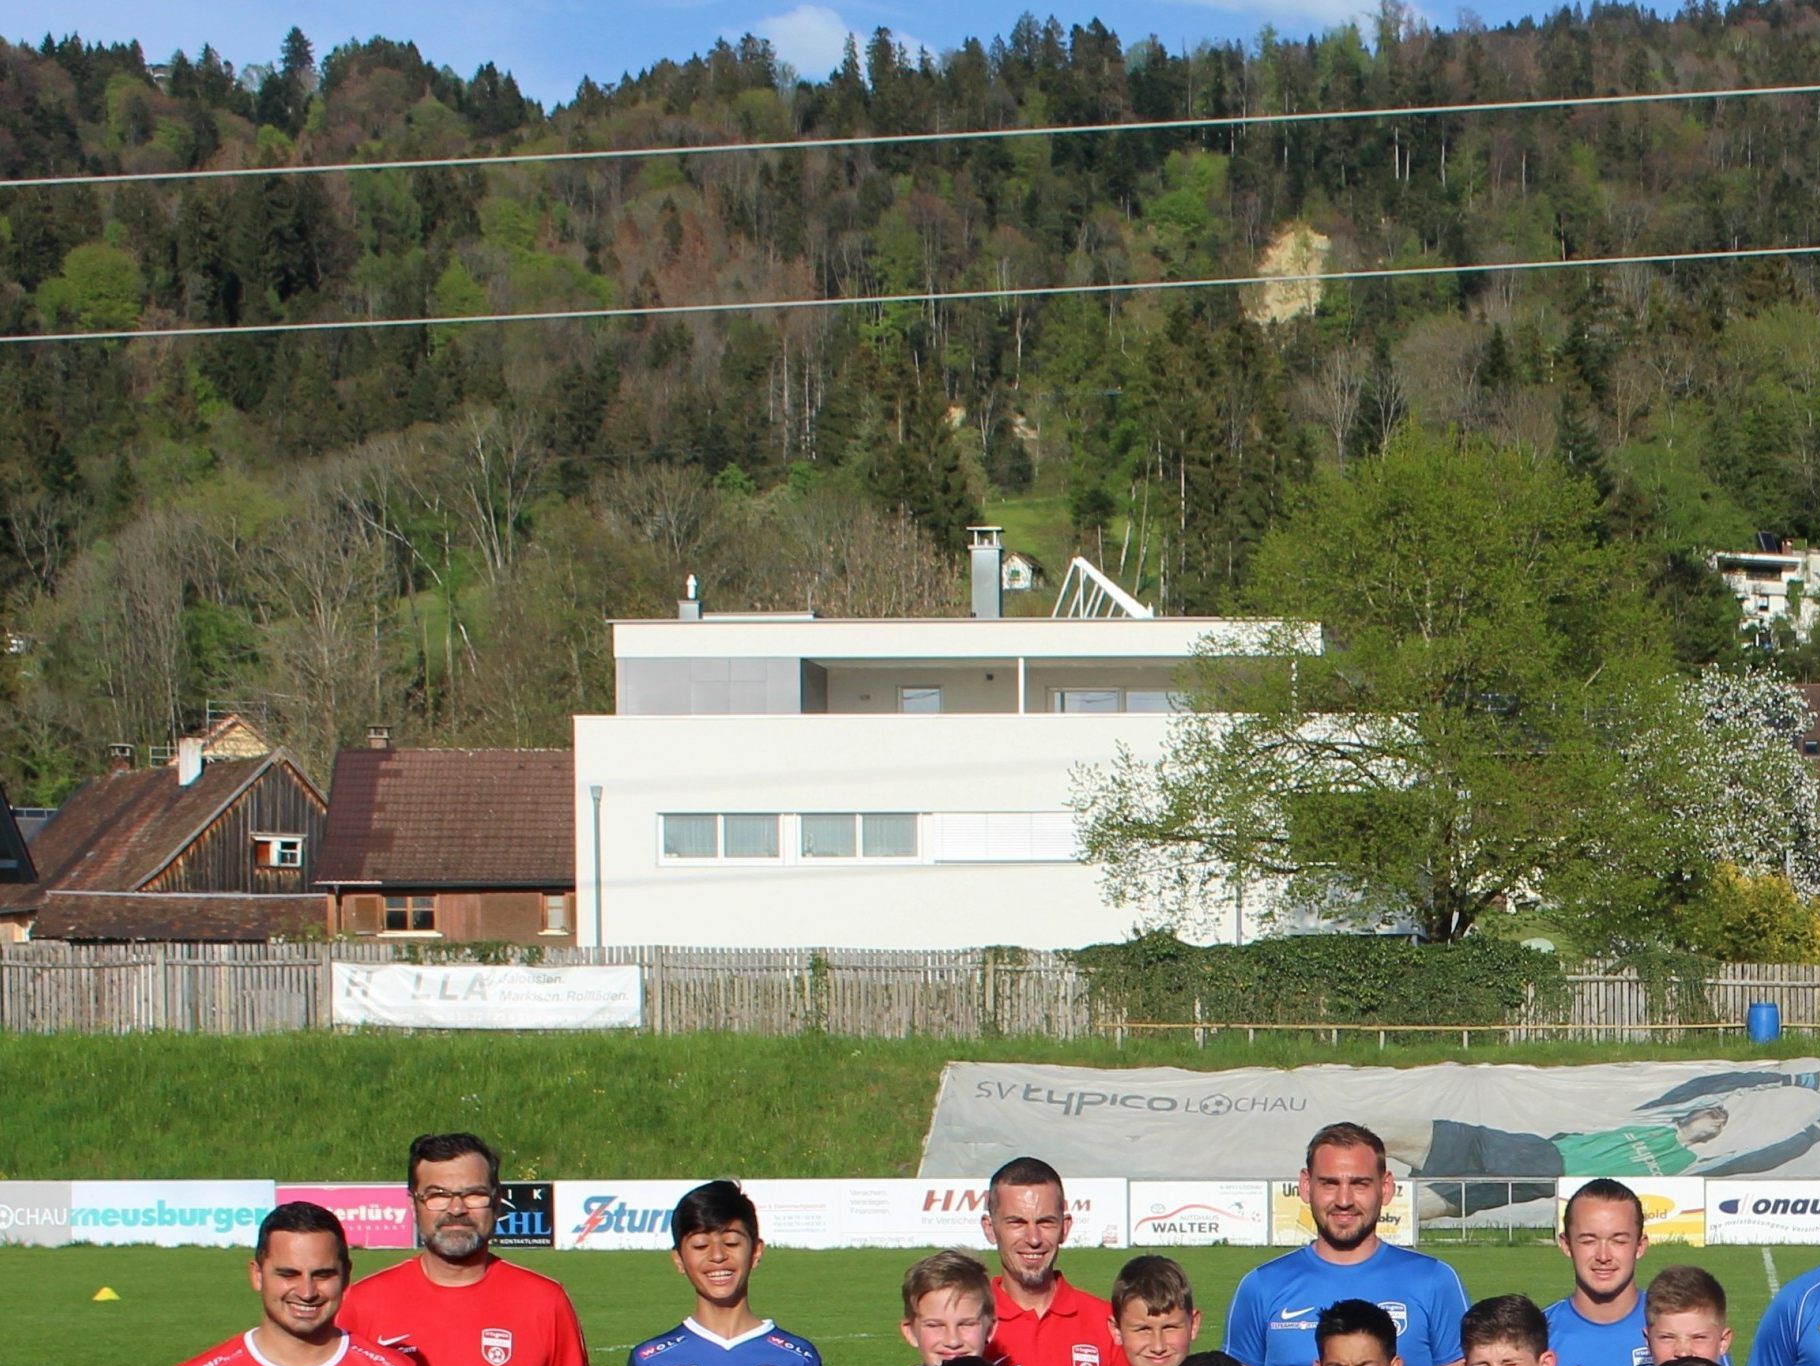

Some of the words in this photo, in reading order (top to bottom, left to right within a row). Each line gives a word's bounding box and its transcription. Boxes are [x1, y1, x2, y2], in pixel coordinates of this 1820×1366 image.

[345, 971, 489, 1000] HLLA
[975, 1081, 1016, 1099] SV
[1022, 1083, 1179, 1116] typico
[327, 1204, 407, 1224] erlüty
[572, 1195, 672, 1233] Stur
[922, 1190, 990, 1211] HM
[70, 1200, 268, 1233] meusburger
[1152, 1222, 1219, 1233] WALTER
